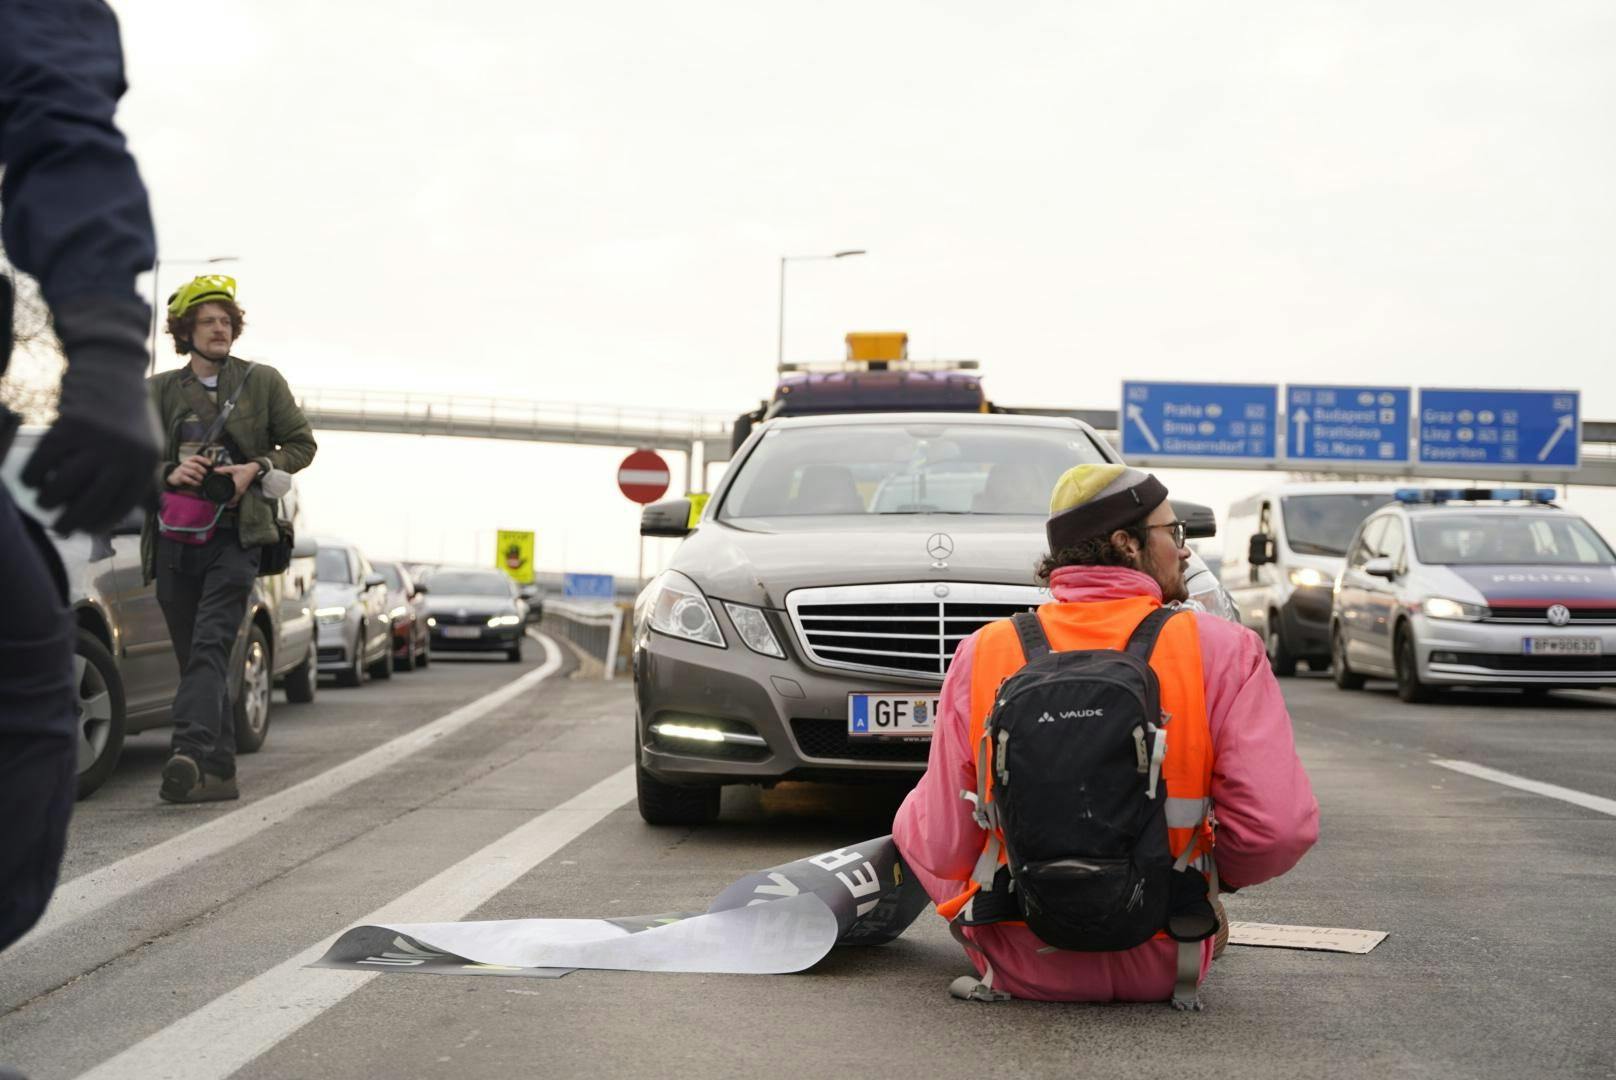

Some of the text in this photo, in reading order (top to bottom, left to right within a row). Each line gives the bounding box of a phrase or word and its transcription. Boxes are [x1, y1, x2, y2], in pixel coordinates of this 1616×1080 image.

[1163, 402, 1202, 417] Praha
[1313, 409, 1376, 424] Budapest
[1423, 409, 1454, 423] Graz
[1163, 420, 1196, 434] Brno
[1313, 425, 1381, 440] Bratislava
[1423, 427, 1451, 441] Linz
[1423, 445, 1487, 459] Favoriten
[1492, 573, 1592, 583] POLIZEI
[875, 700, 908, 727] GF
[1059, 708, 1103, 719] VAUDE
[857, 718, 865, 727] A
